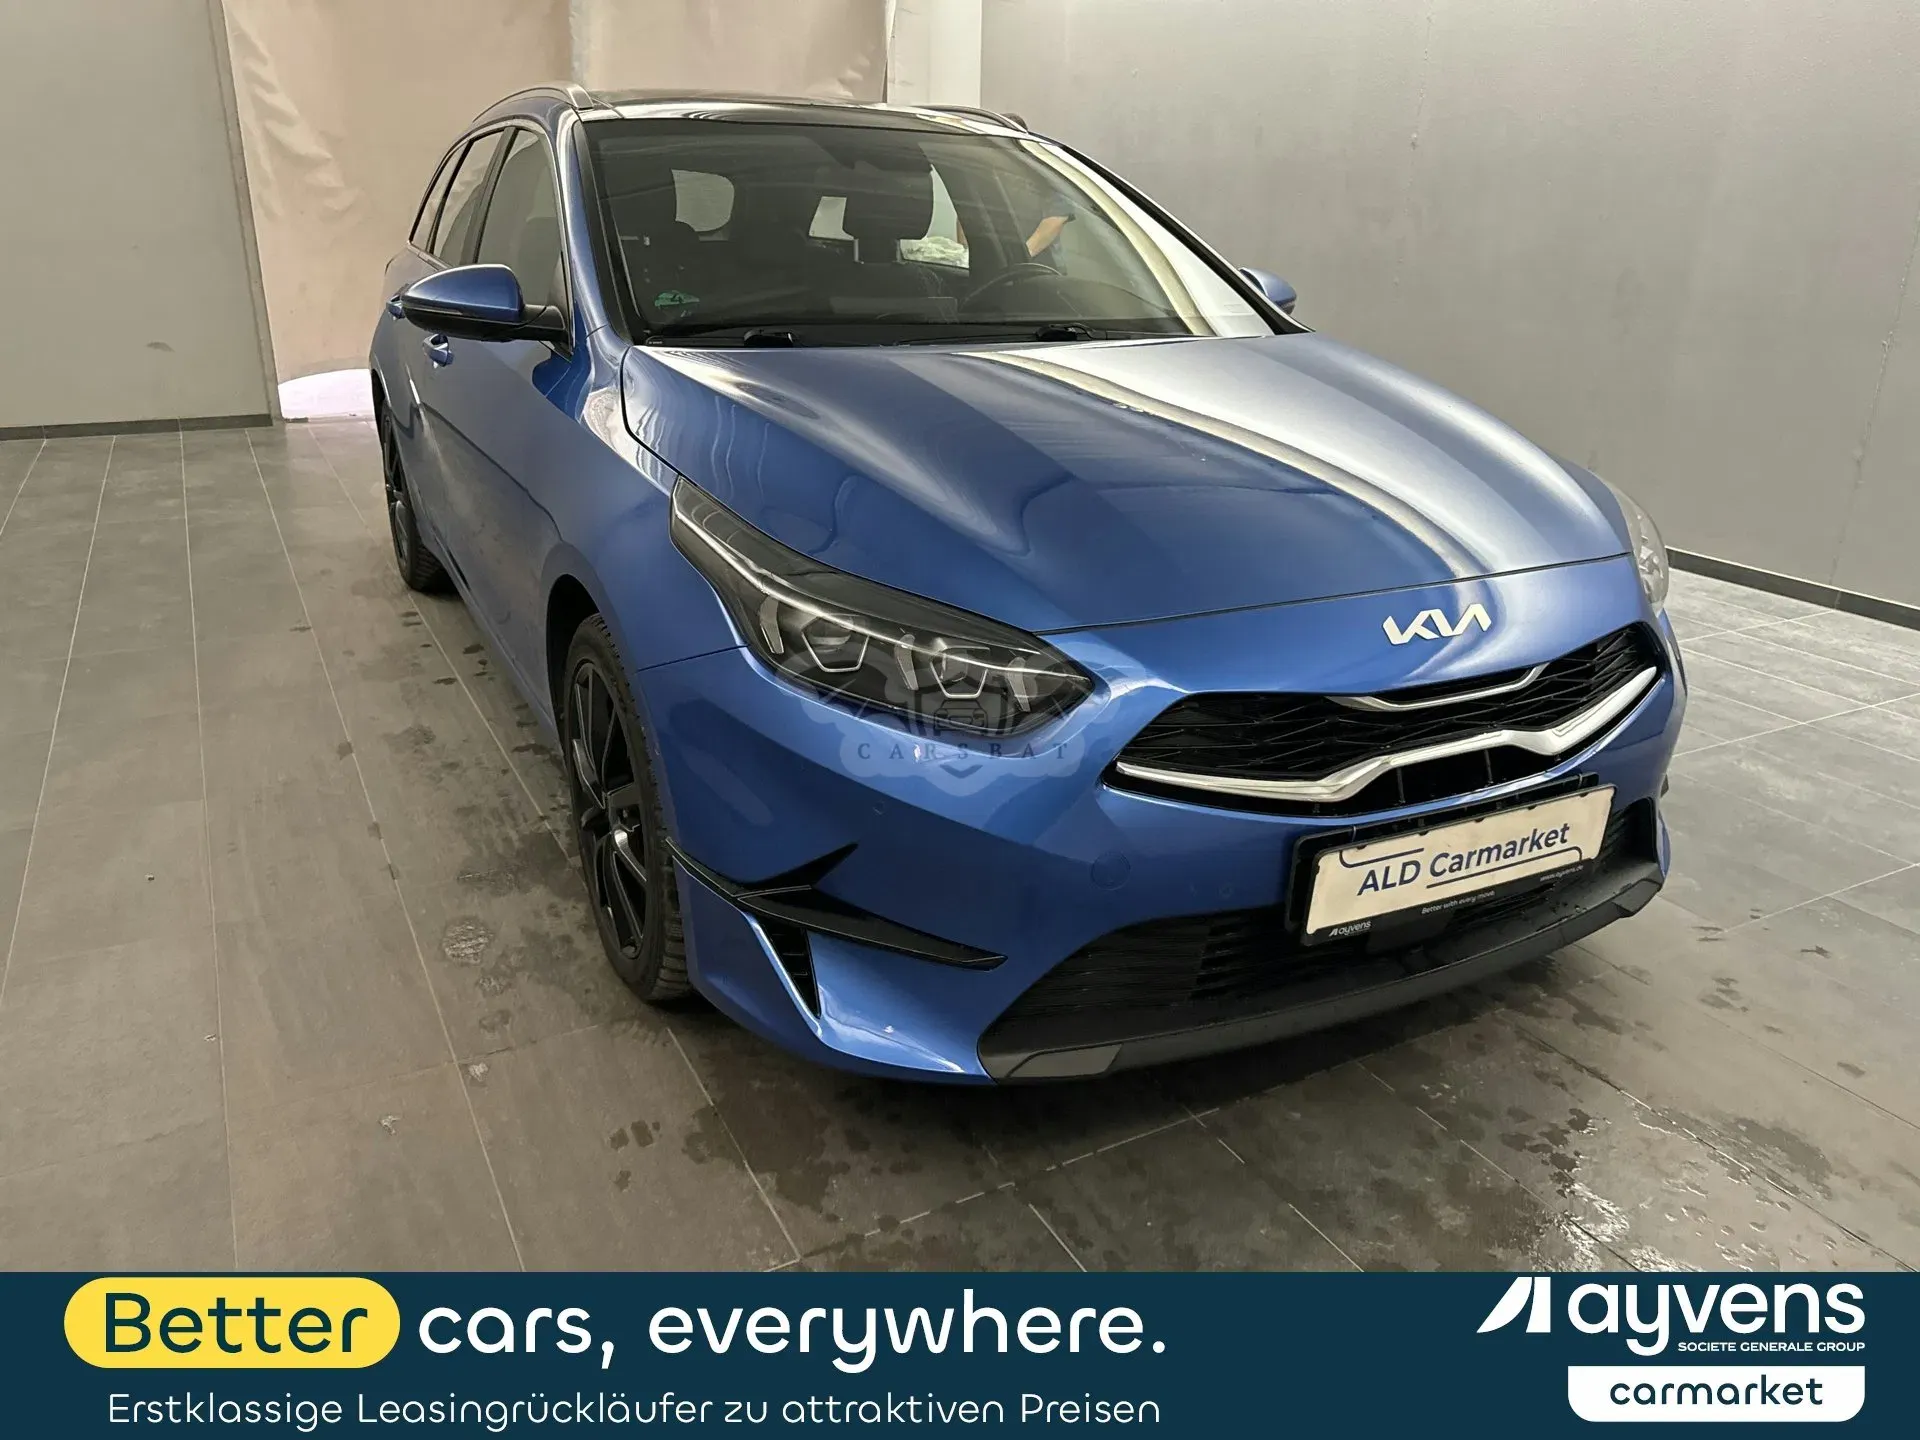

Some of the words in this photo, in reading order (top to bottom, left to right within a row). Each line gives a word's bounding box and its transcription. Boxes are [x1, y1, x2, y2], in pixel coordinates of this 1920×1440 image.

[1382, 603, 1492, 645] KIA
[1357, 860, 1421, 896] ALD
[1430, 823, 1570, 878] Carmarket
[1443, 900, 1458, 909] with
